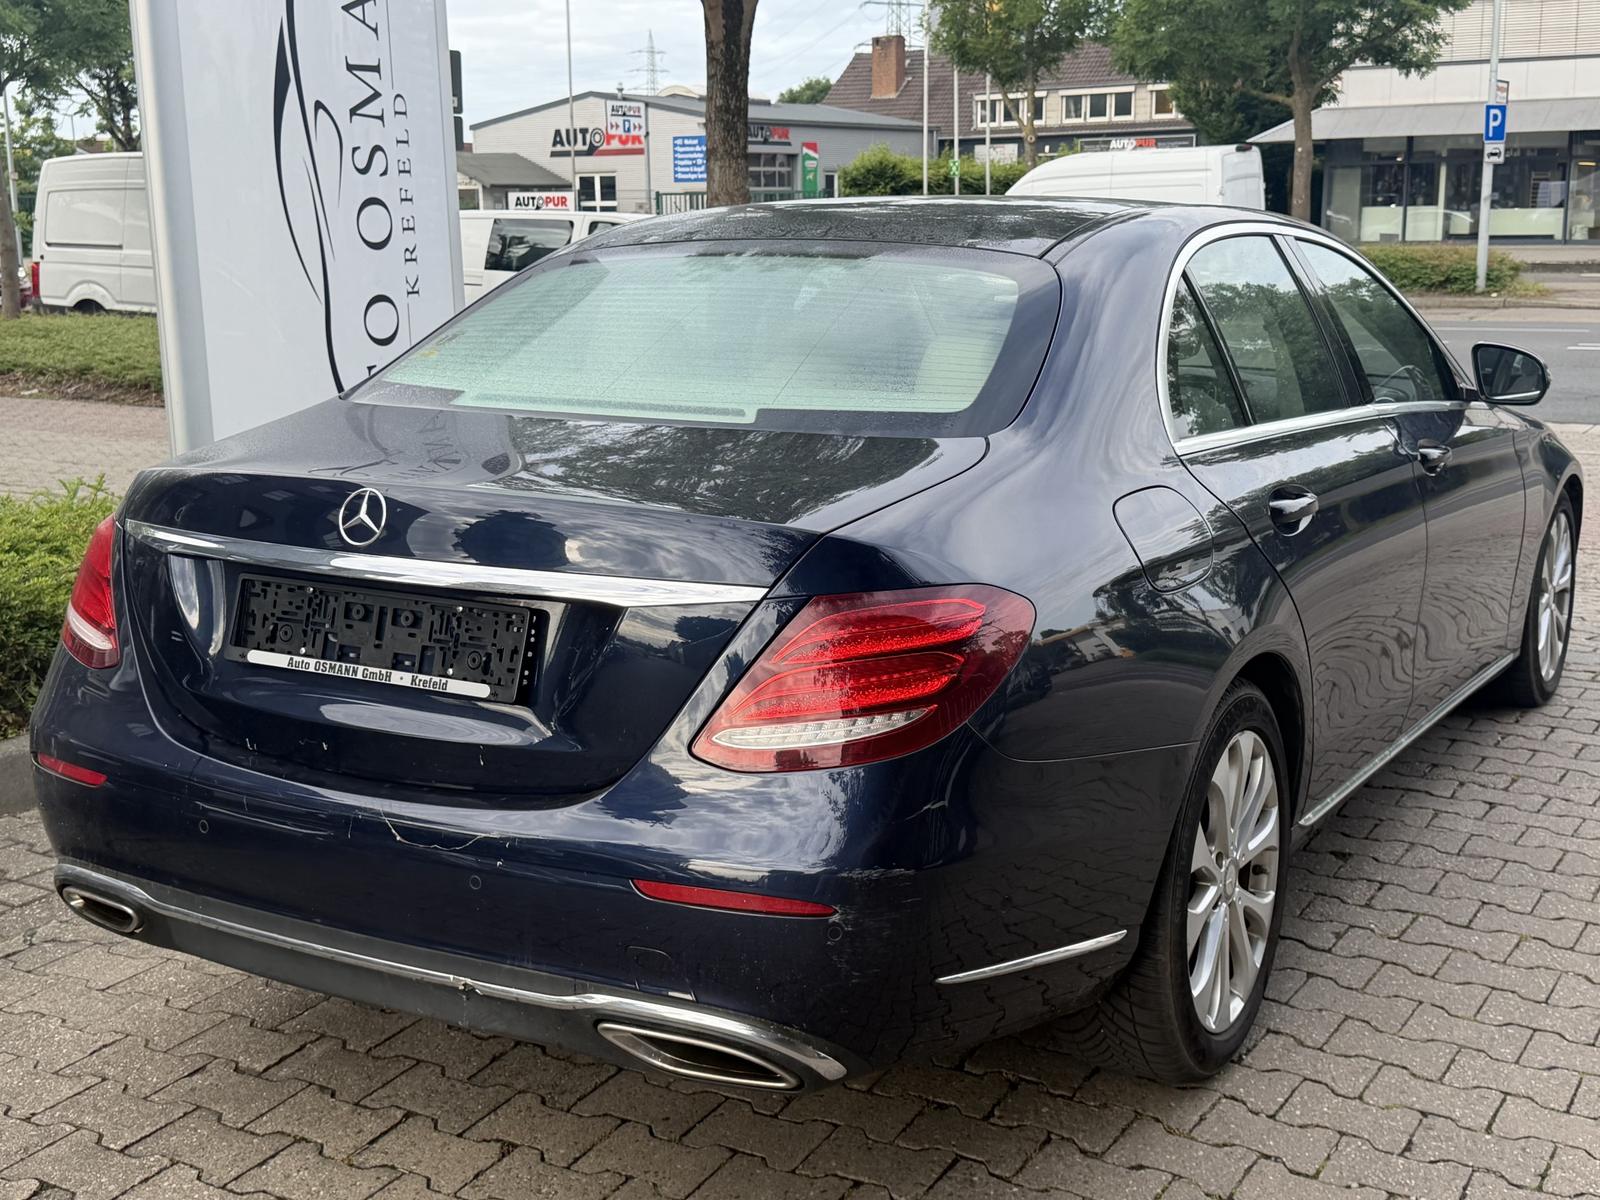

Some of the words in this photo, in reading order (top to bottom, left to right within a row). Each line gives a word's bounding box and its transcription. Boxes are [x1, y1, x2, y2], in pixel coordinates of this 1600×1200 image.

[1488, 108, 1502, 137] P
[1110, 137, 1157, 150] AUTOPUR
[393, 93, 420, 298] KREFELD
[515, 195, 568, 209] AUTOPUR
[286, 656, 311, 670] Auto
[314, 661, 359, 678] OSMANN
[361, 667, 393, 683] GmbH
[410, 674, 448, 691] Krefeld
